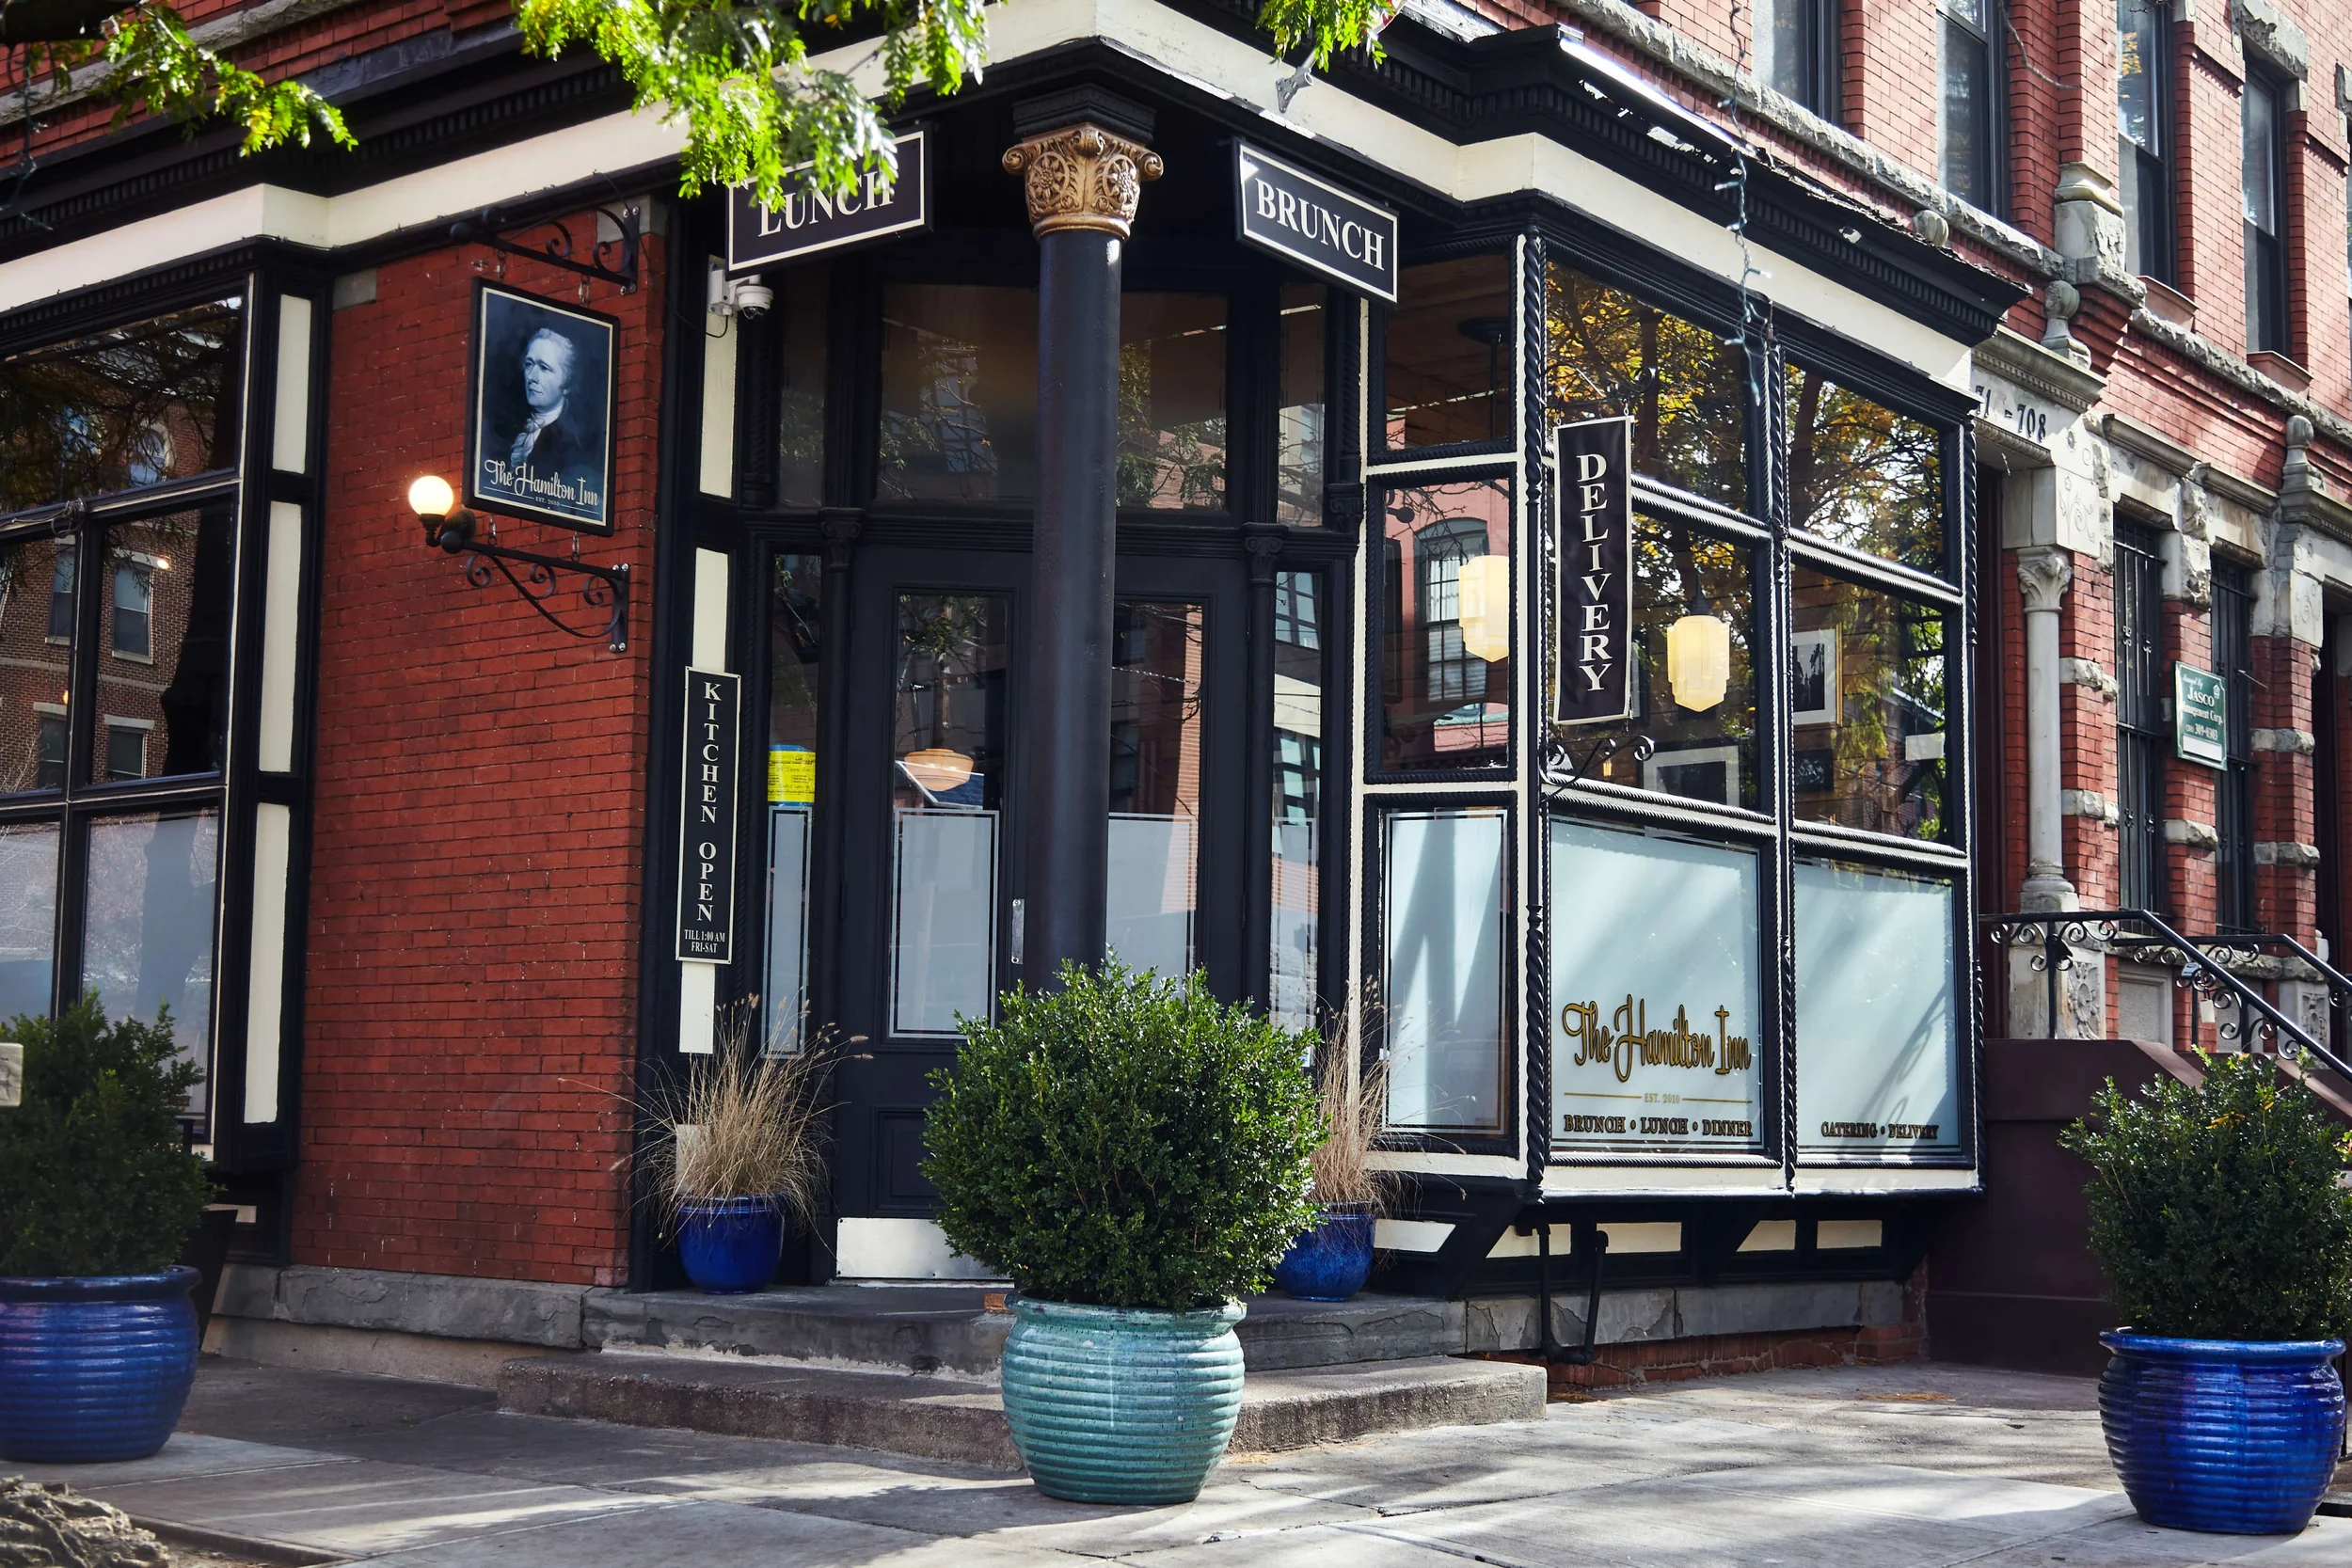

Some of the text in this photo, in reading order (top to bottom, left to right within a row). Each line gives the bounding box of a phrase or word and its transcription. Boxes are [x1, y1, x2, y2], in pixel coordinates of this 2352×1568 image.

[758, 170, 894, 237] LUNCH
[1254, 177, 1385, 271] BRUNCH
[484, 459, 598, 506] The Hamilton Inn
[1576, 453, 1613, 691] DELIVERY
[2187, 686, 2215, 707] JASCO
[701, 681, 723, 824] KITCHEN
[696, 842, 717, 923] OPEN
[684, 928, 725, 942] TILL 1:00 AM
[691, 942, 718, 954] FRI-SAT
[1562, 993, 1752, 1083] The Hamilton Inn
[1644, 1092, 1681, 1104] EST. 2010
[1564, 1114, 1754, 1137] BRUNCH LUNCH DINNER
[1820, 1121, 1940, 1140] CATERING DELIVERY
